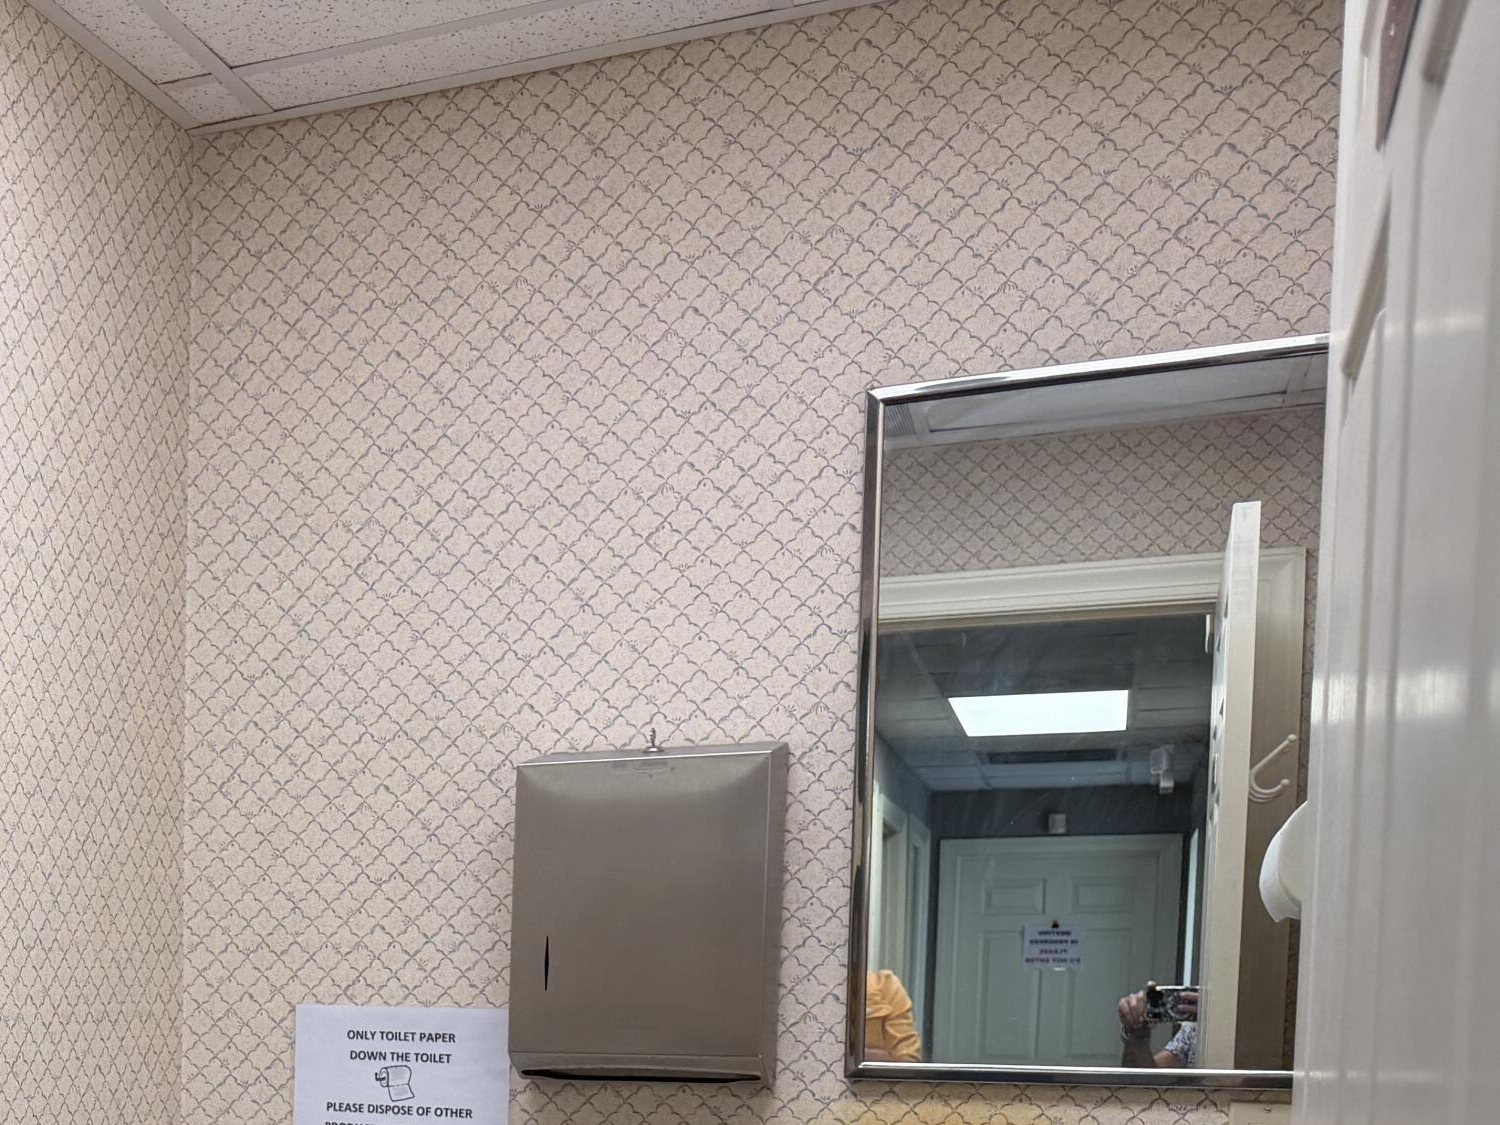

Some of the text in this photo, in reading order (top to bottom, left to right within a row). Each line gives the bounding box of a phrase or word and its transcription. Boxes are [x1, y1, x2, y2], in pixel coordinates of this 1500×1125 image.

[347, 1030, 455, 1043] ONLY TOILET PAPER
[350, 1050, 452, 1064] DOWN THE TOILET
[326, 1102, 472, 1118] PLEASE DISPOSE OF OTHER
